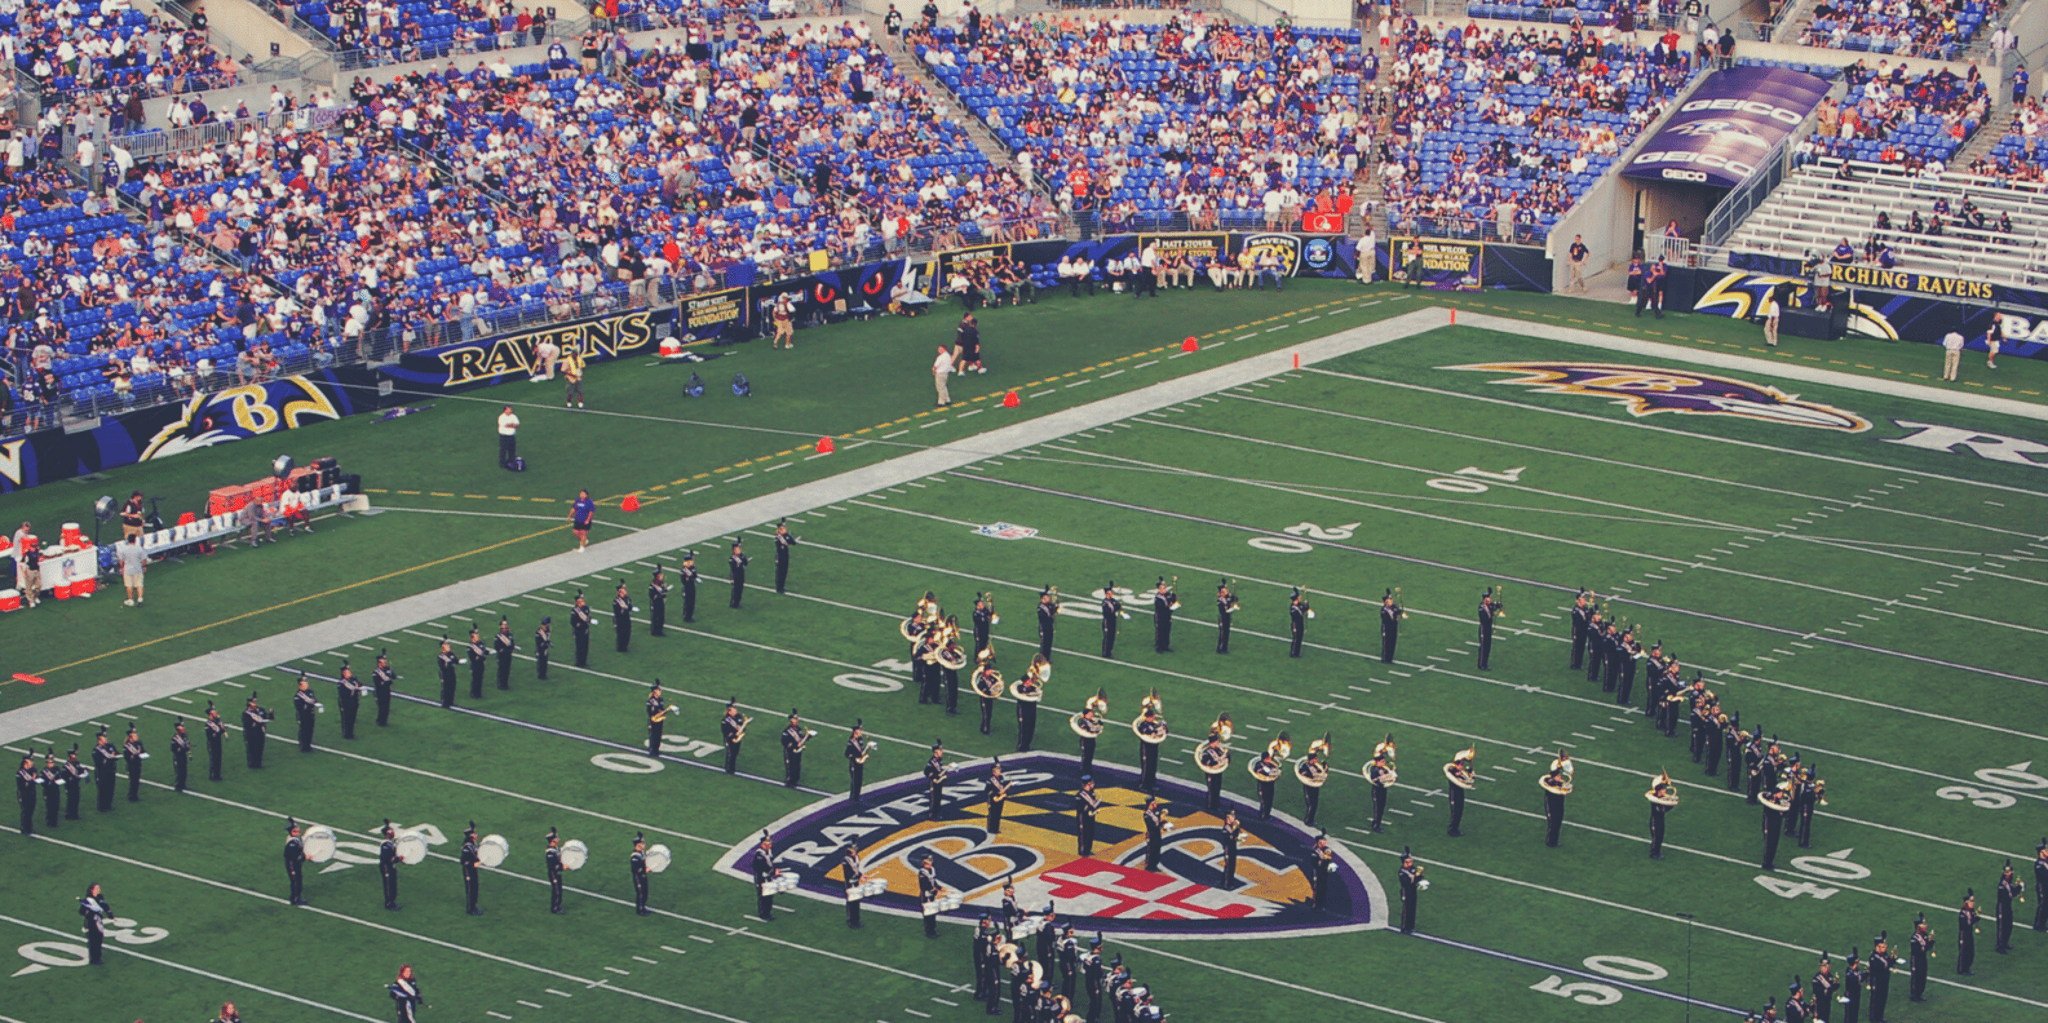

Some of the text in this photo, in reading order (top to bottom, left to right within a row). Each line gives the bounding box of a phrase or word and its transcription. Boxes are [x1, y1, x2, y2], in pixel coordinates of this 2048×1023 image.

[1681, 99, 1803, 125] GEICO
[1633, 151, 1755, 177] GEICO
[1662, 169, 1707, 182] GEICO
[1162, 240, 1183, 248] MATT
[1184, 240, 1213, 248] STOVER
[1251, 237, 1295, 247] RAVENS
[1917, 274, 1993, 299] RAVENS
[438, 311, 651, 386] RAVENS
[1426, 465, 1527, 494] 10
[1246, 520, 1363, 554] 20
[590, 735, 725, 774] 50
[1935, 767, 2048, 810] 30
[1752, 855, 1872, 900] 40
[17, 917, 170, 967] 30
[1529, 954, 1669, 1006] 50
